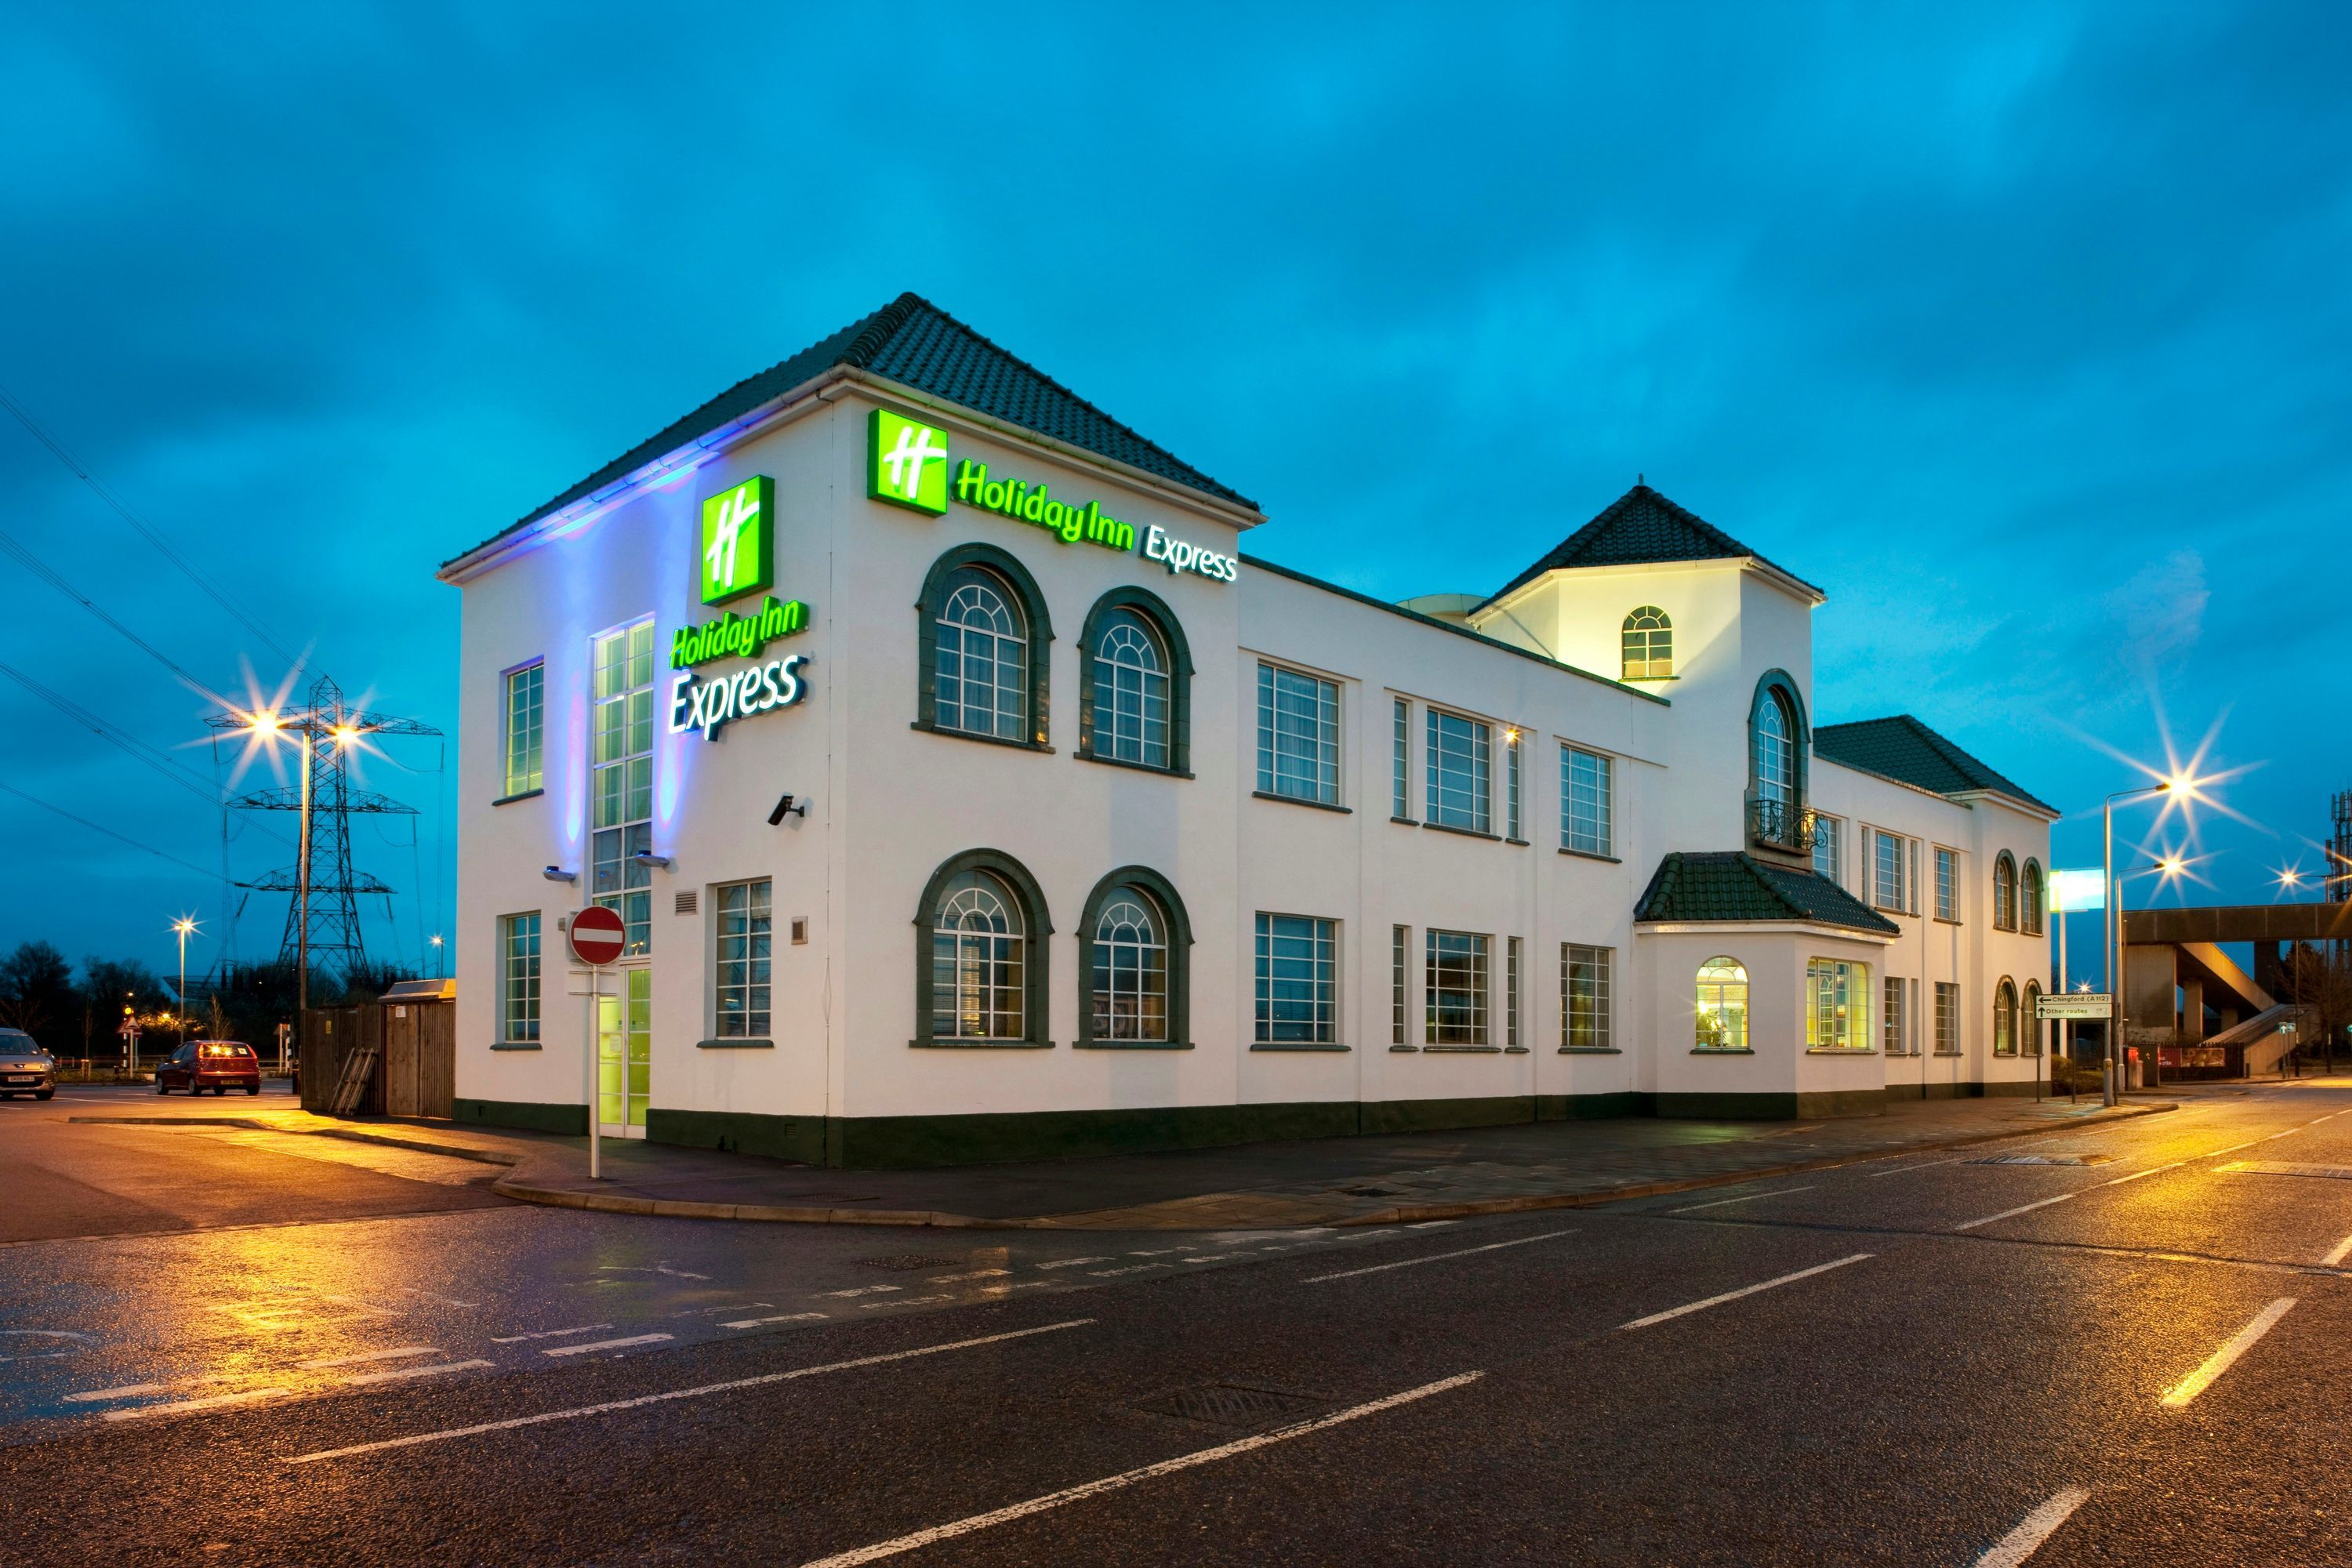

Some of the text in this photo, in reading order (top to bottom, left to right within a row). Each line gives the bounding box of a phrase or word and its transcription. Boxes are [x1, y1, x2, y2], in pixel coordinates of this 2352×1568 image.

[883, 426, 947, 499] H
[706, 487, 760, 587] H
[956, 459, 1238, 582] Holiday Inn Express
[670, 596, 801, 670] Holiday Inn
[669, 655, 800, 741] Express
